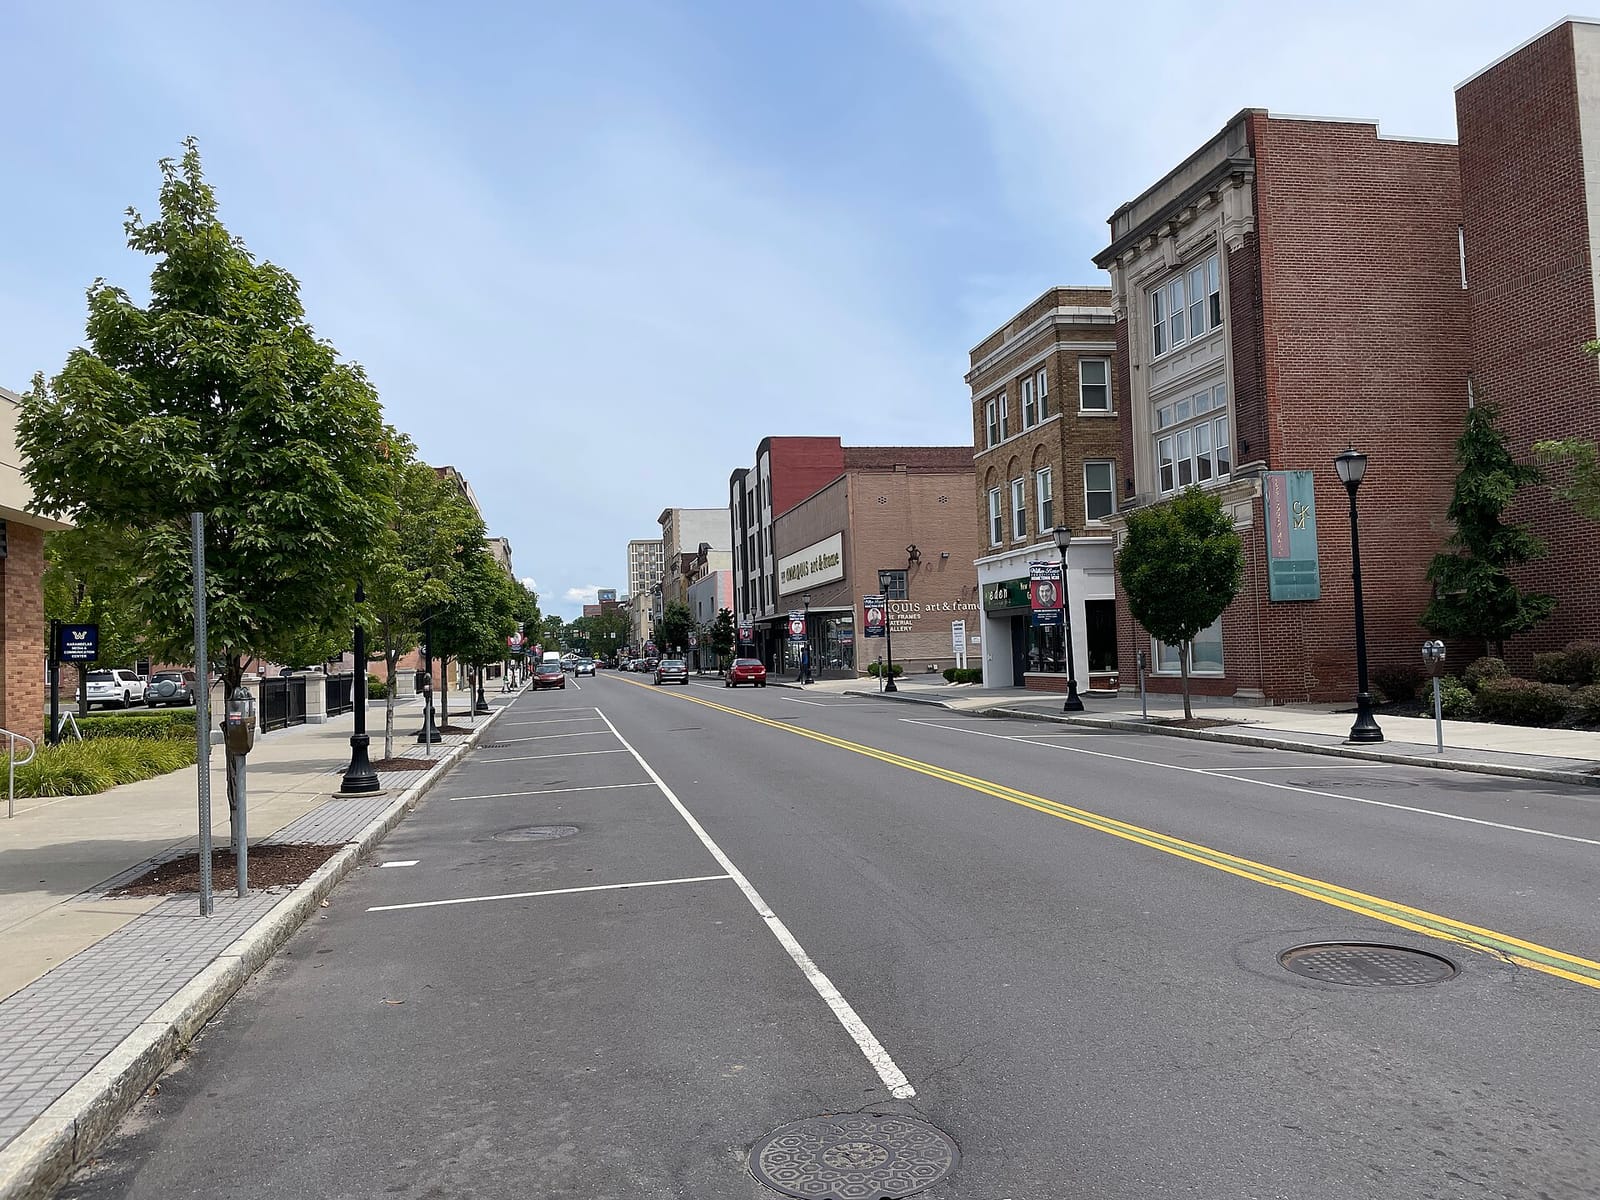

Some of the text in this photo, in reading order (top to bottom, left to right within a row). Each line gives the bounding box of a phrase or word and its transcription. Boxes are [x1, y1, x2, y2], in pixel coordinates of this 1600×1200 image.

[810, 557, 818, 573] art
[823, 552, 839, 569] frame
[990, 583, 1007, 600] eden
[925, 602, 941, 612] art
[942, 601, 952, 611] &
